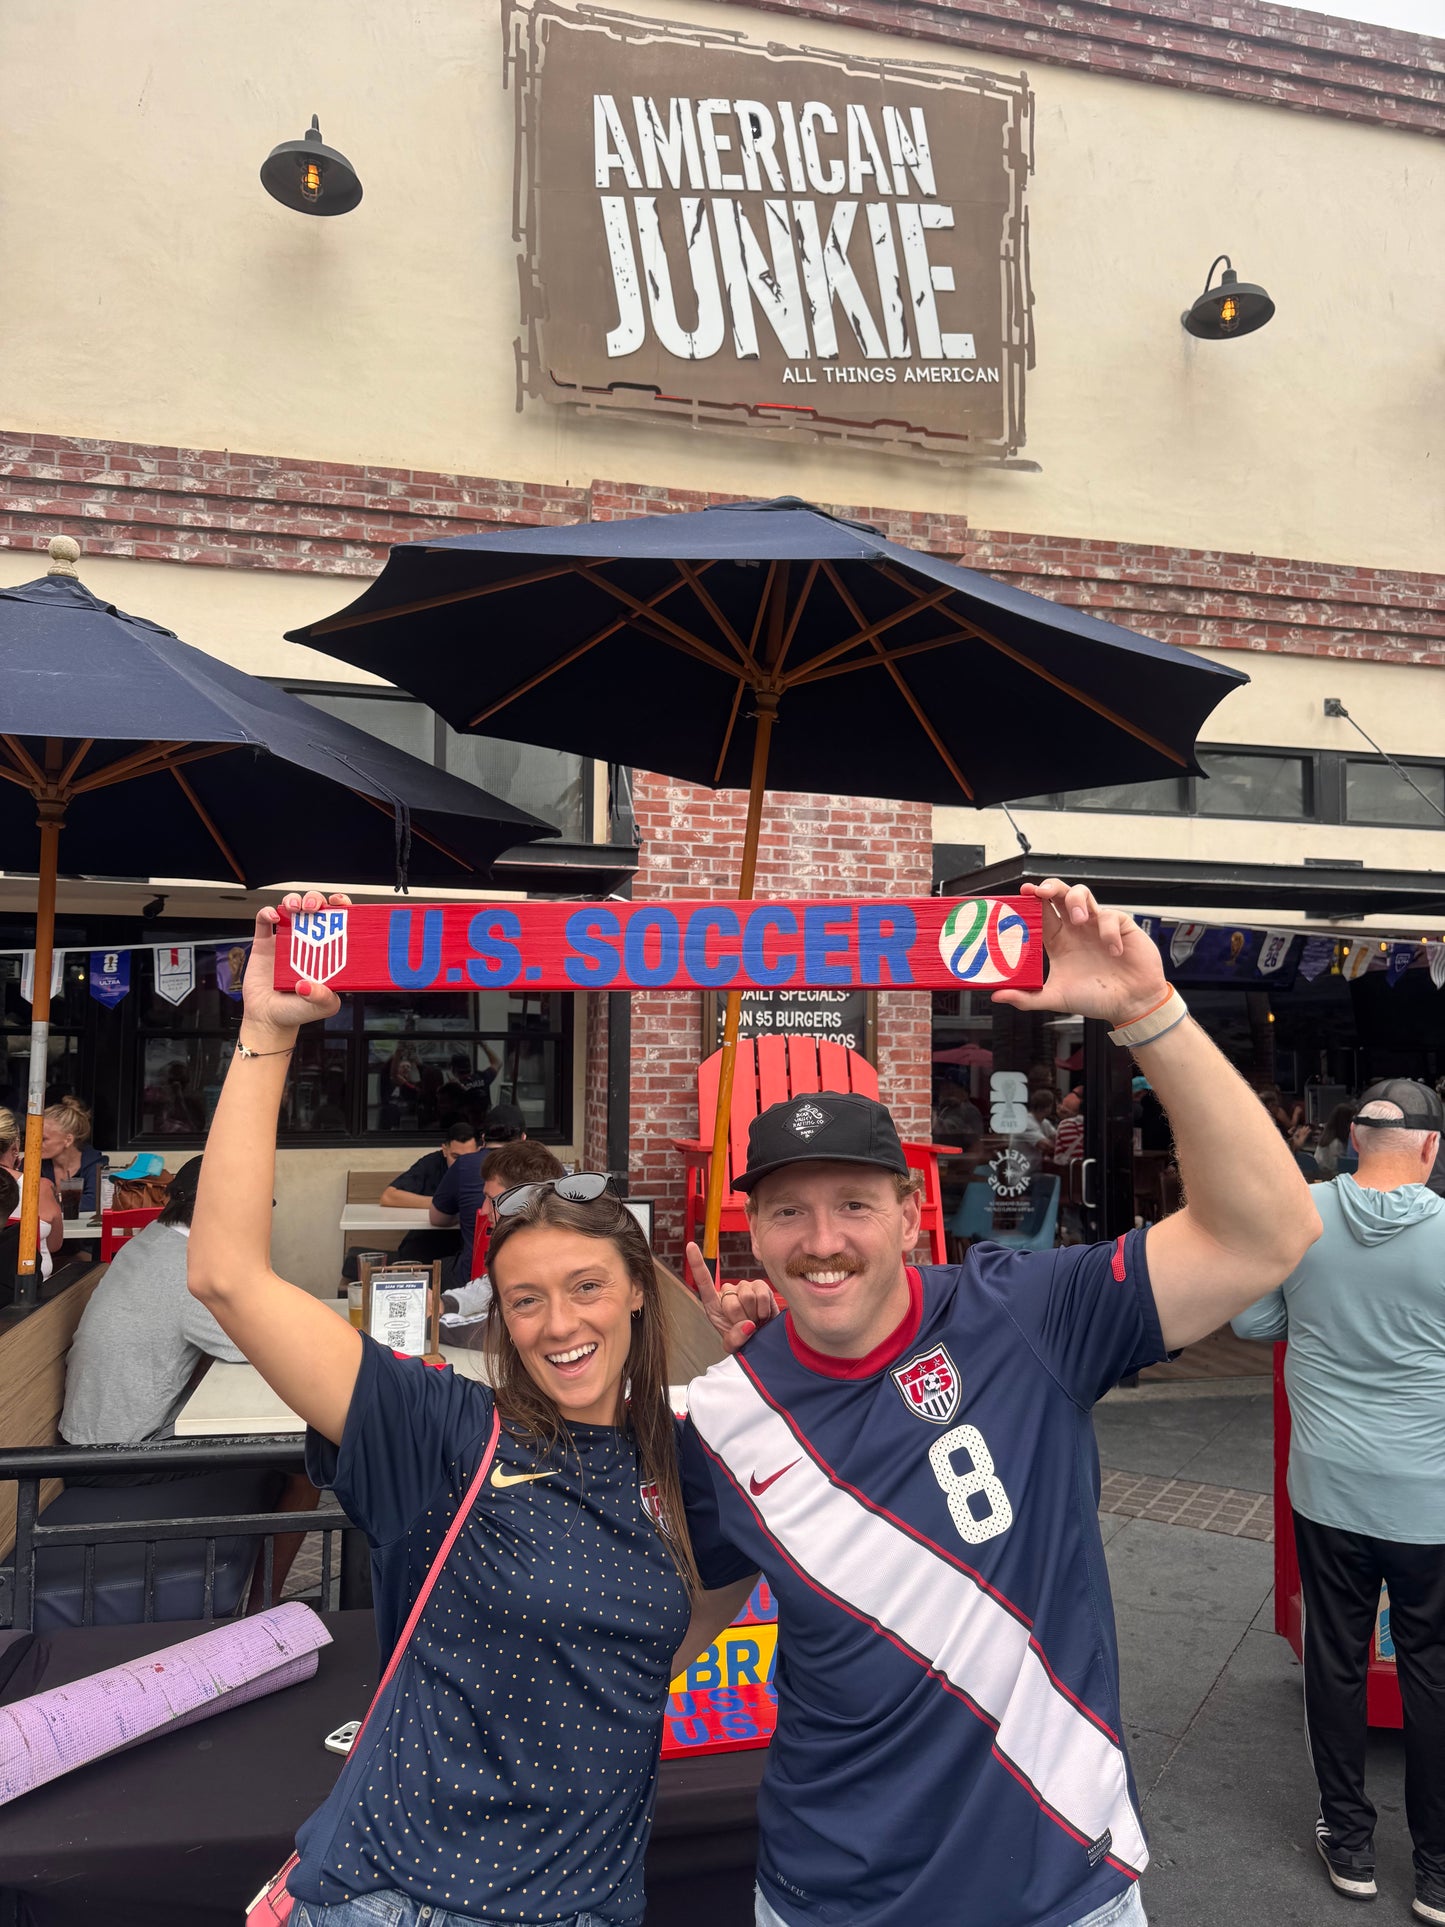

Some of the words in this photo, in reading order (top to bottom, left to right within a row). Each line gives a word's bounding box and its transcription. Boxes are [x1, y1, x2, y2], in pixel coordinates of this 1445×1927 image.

[593, 94, 937, 197] AMERICAN
[600, 196, 977, 360] JUNKIE
[782, 367, 817, 383] ALL
[823, 367, 897, 383] THINGS
[903, 367, 1000, 383] AMERICAN
[294, 911, 345, 942] USA
[388, 909, 542, 990] U.S.
[564, 903, 918, 989] SOCCER
[755, 1011, 773, 1027] $5
[776, 1011, 842, 1028] BURGERS
[929, 1424, 1013, 1545] 8
[671, 1713, 772, 1746] U.S.
